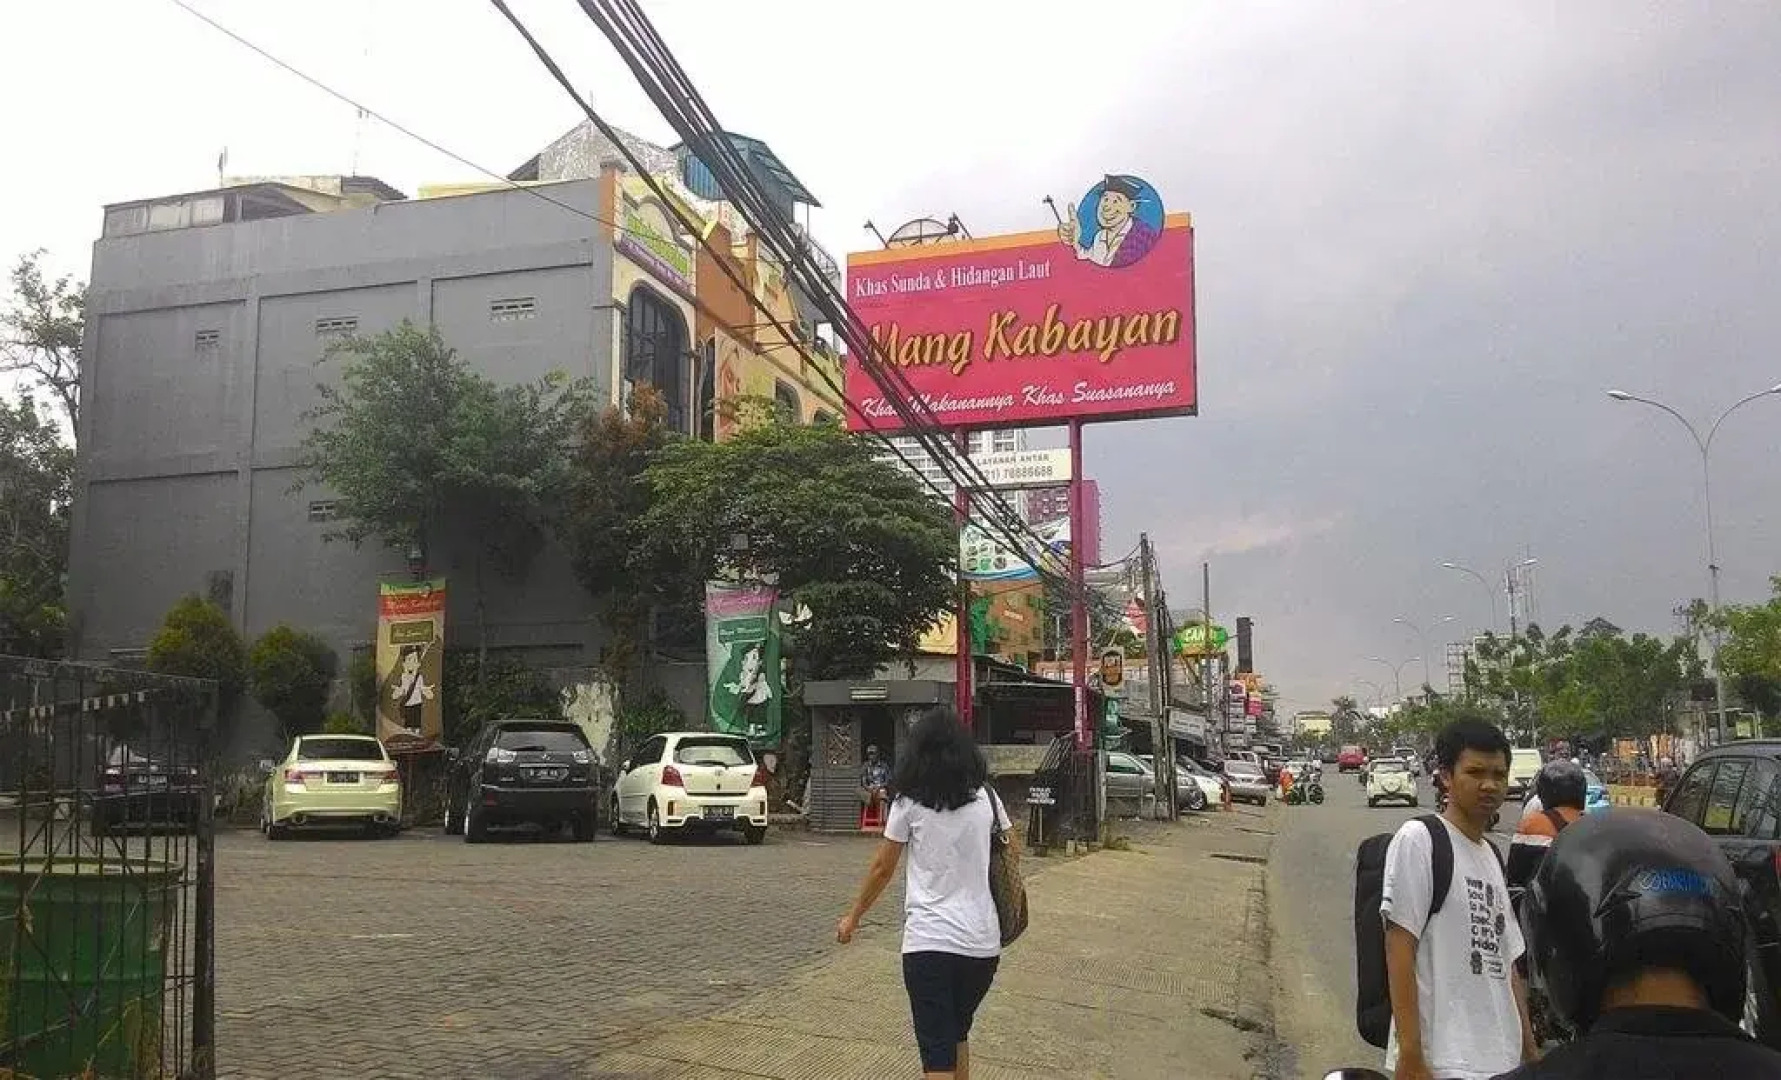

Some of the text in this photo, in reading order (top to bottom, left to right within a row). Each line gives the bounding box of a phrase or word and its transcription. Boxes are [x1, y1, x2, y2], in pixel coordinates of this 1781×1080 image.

[855, 259, 1051, 298] Khas Sunda & Hidangan Laut
[871, 302, 1180, 376] Mang Kabayan
[1021, 385, 1065, 406] Khas
[1071, 379, 1177, 404] Suasananya
[1020, 453, 1050, 462] ANTAR
